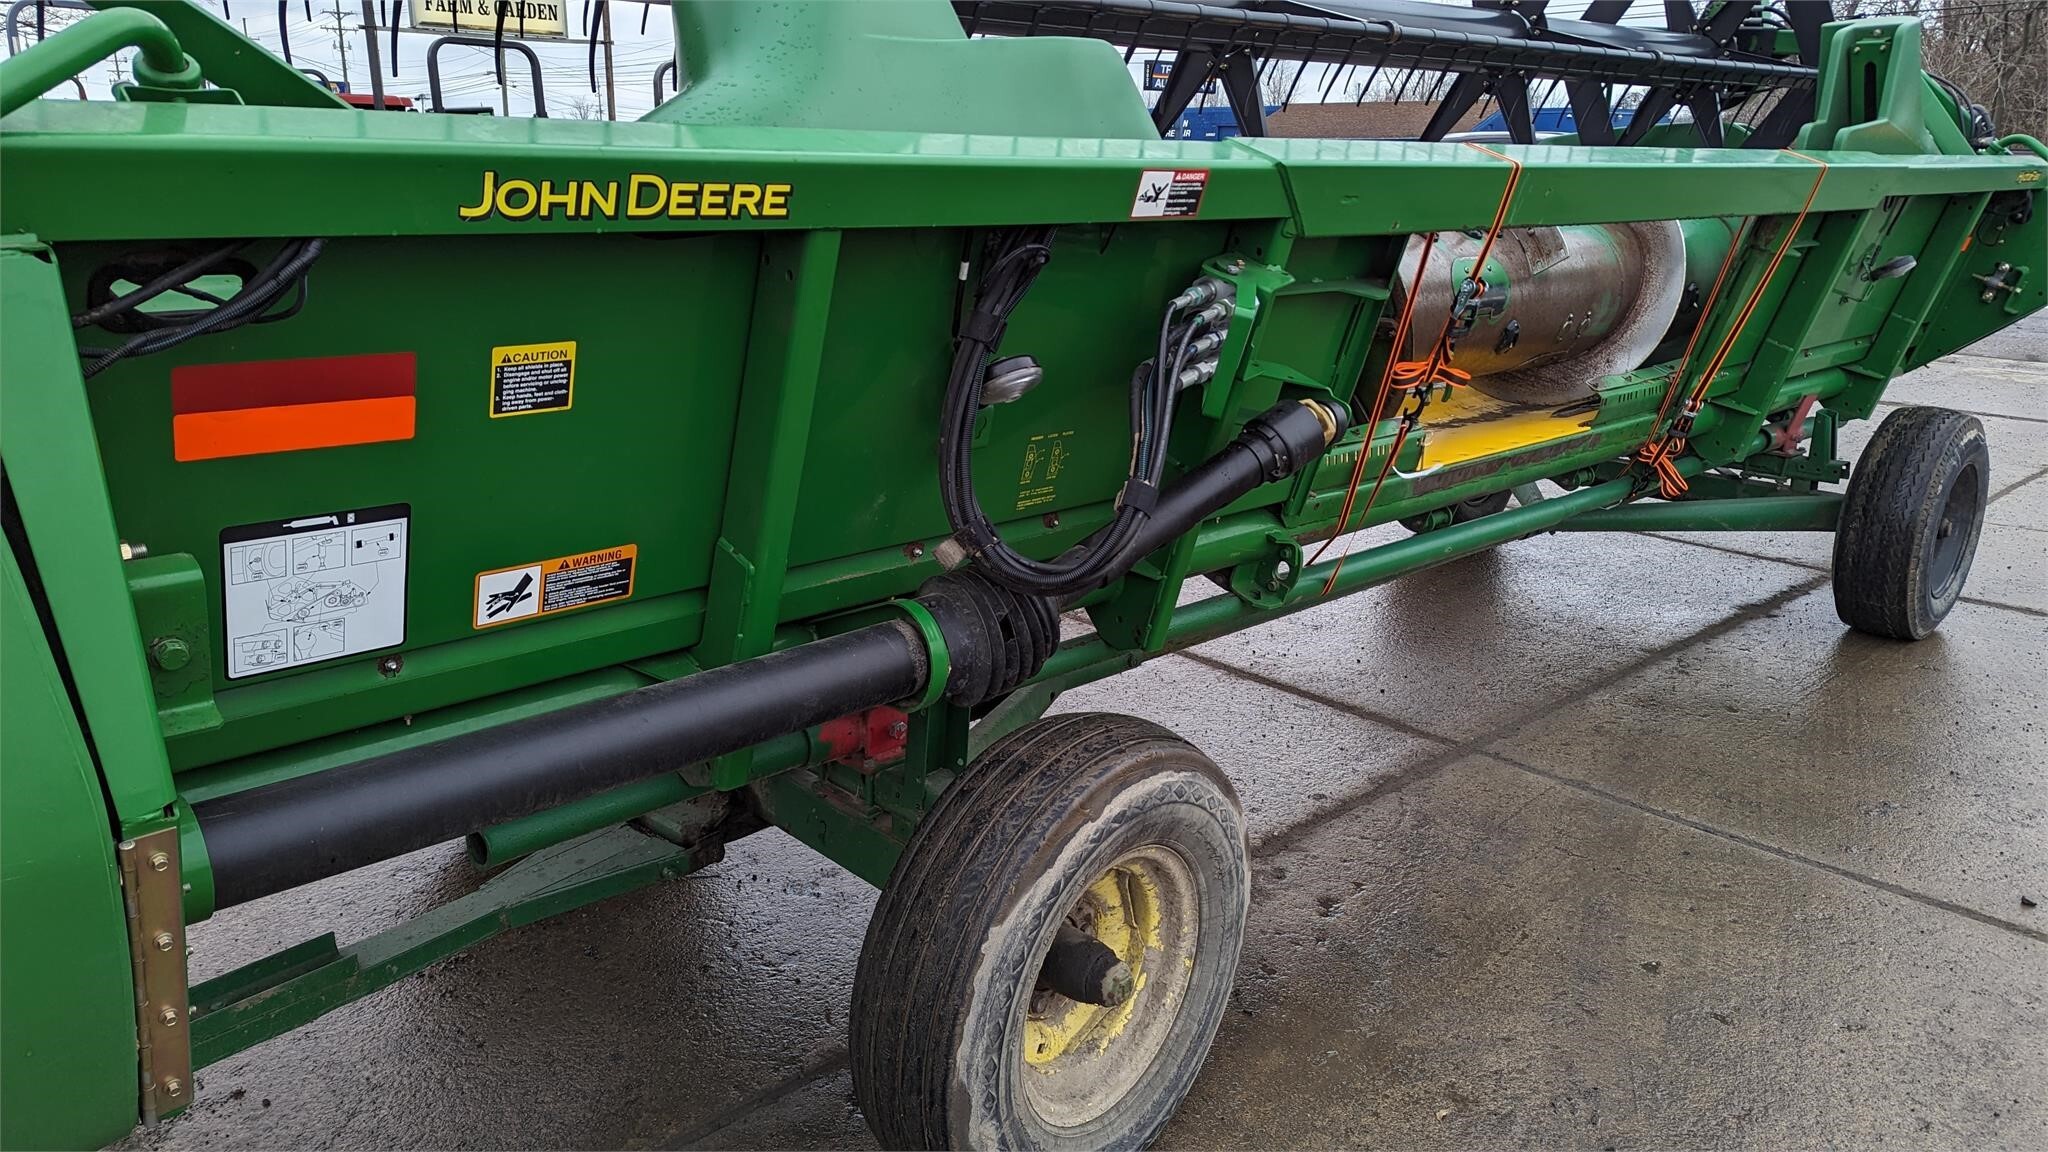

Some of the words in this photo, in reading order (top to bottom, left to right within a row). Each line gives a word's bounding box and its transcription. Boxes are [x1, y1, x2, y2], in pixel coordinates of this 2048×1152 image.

[478, 0, 491, 16] &
[1181, 172, 1206, 181] DANGER
[459, 171, 621, 221] JOHN
[626, 173, 793, 220] DEERE
[513, 350, 568, 362] CAUTION
[572, 550, 622, 567] WARNING
